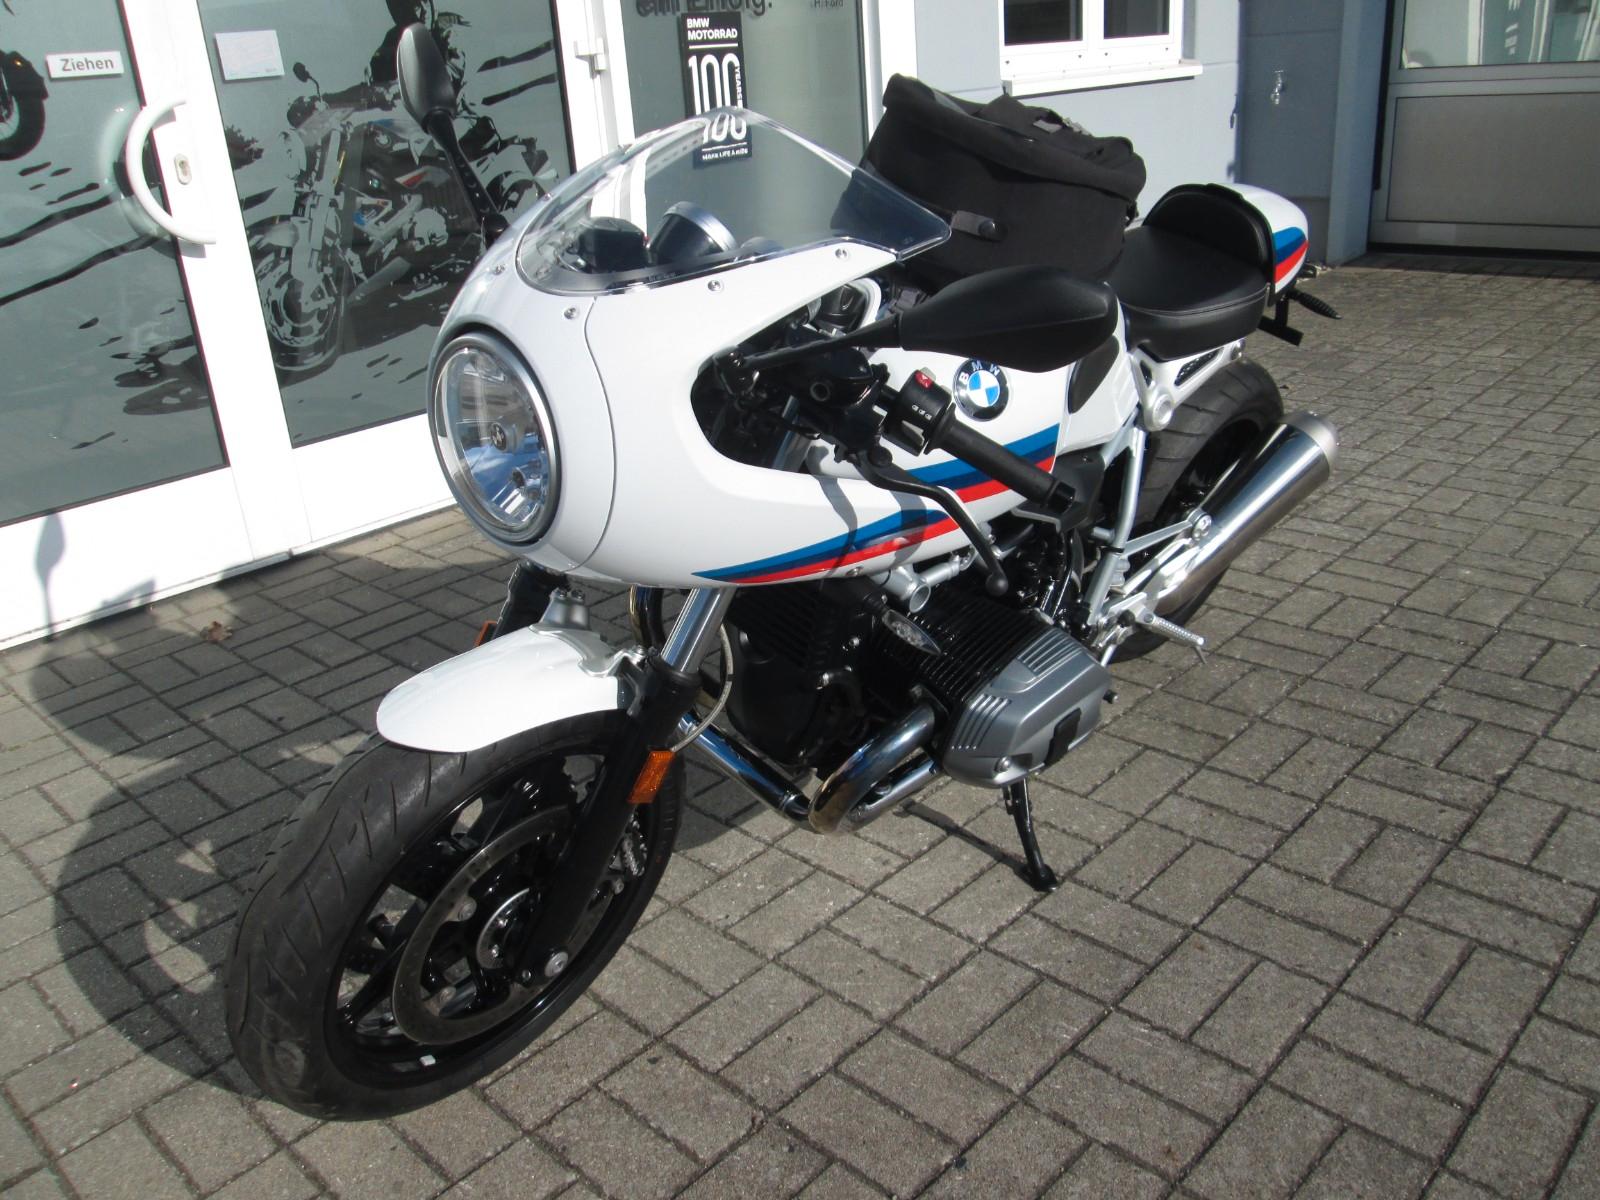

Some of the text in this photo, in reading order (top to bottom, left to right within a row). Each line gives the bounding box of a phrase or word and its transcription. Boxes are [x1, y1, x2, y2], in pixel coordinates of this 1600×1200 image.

[686, 17, 709, 28] BMW
[687, 28, 738, 40] MOTORRAD
[60, 57, 114, 72] Ziehen
[688, 53, 744, 116] 100
[959, 360, 1000, 385] BMW
